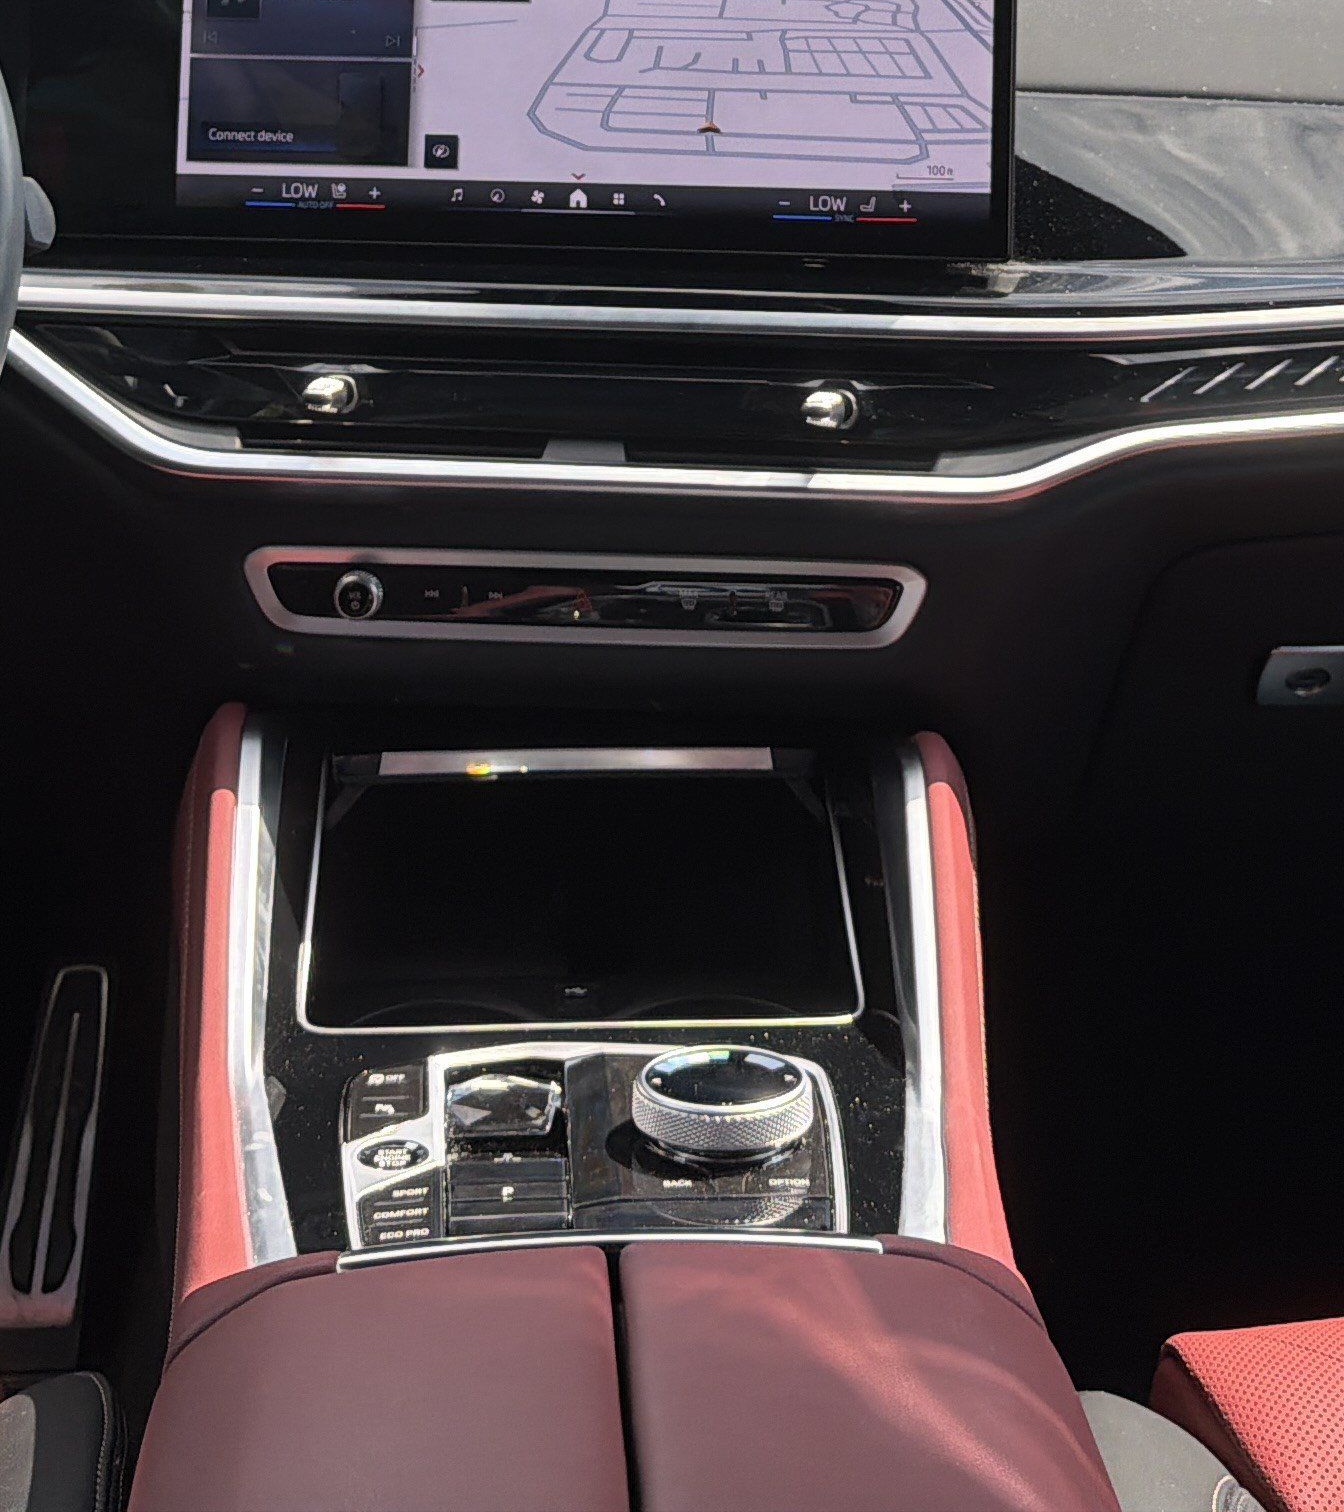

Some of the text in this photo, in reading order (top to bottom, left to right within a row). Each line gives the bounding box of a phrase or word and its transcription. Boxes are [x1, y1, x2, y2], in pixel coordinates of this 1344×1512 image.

[207, 127, 294, 143] Connect device
[926, 164, 946, 176] 100
[281, 182, 319, 199] LOW
[808, 195, 847, 212] LOW
[385, 1073, 406, 1084] OFF
[662, 1178, 693, 1188] BACK
[768, 1177, 811, 1188] OPTION
[392, 1187, 430, 1198] SPORT
[373, 1207, 430, 1220] COMFORT
[379, 1227, 430, 1241] ECO PRO
